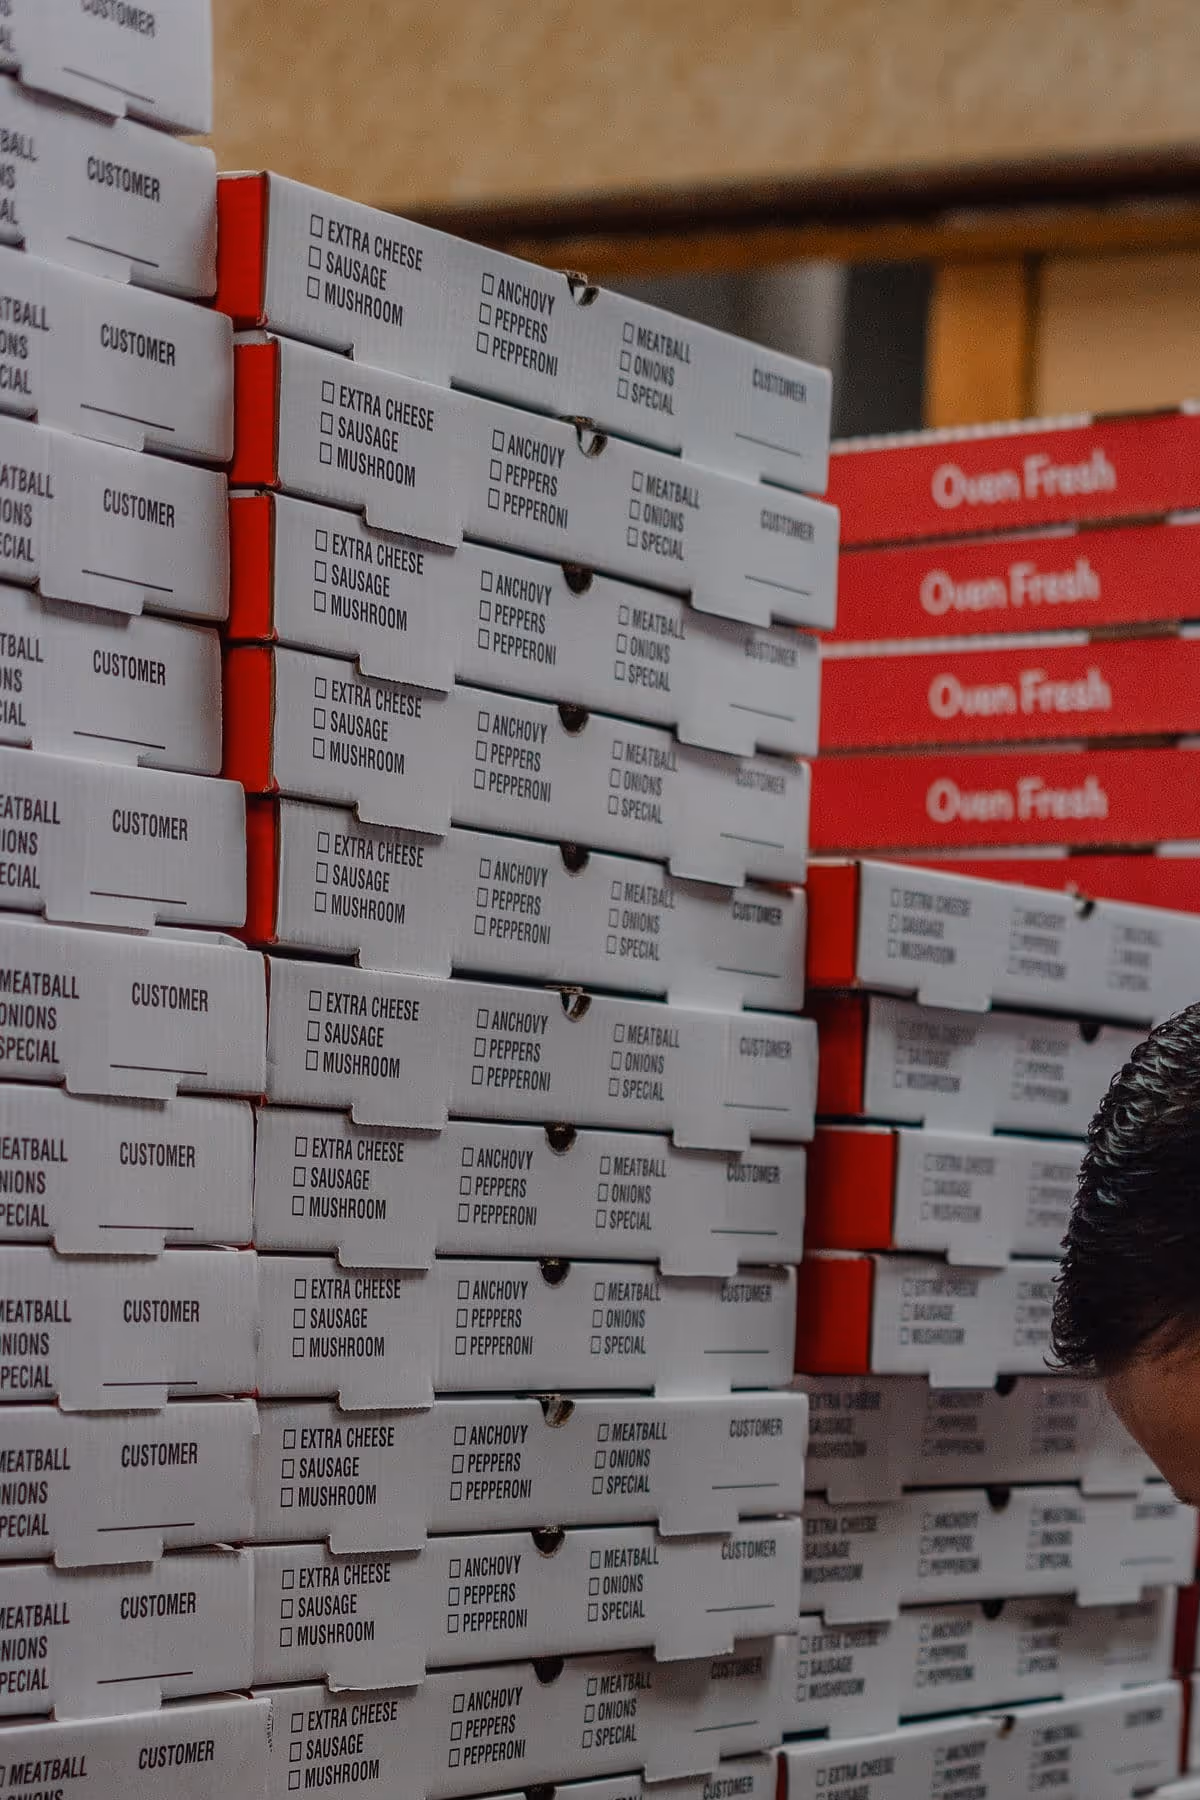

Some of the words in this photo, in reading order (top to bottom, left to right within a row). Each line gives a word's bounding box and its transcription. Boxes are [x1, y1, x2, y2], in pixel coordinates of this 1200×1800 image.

[87, 156, 160, 201] CUSTOMER
[327, 219, 369, 254] EXTRA
[373, 234, 423, 272] CHEESE
[326, 250, 387, 292] SAUSAGE
[324, 280, 403, 328] MUSHROOM
[496, 277, 555, 316] ANCHOVY
[494, 306, 548, 345] PEPPERS
[101, 323, 176, 366] CUSTOMER
[492, 335, 558, 377] PEPPERONI
[339, 384, 381, 417] EXTRA
[385, 397, 434, 432] CHEESE
[338, 415, 399, 453] SAUSAGE
[506, 433, 565, 469] ANCHOVY
[337, 445, 415, 488] MUSHROOM
[505, 462, 558, 497] PEPPERS
[931, 463, 1021, 509] Oven
[1024, 448, 1116, 498] Fresh
[104, 488, 174, 528] CUSTOMER
[503, 491, 568, 529] PEPPERONI
[332, 532, 372, 563] EXTRA
[376, 543, 424, 575] CHEESE
[331, 563, 390, 598] SAUSAGE
[495, 573, 552, 606] ANCHOVY
[920, 569, 1006, 615] Oven
[1009, 555, 1100, 606] Fresh
[331, 593, 407, 632] MUSHROOM
[494, 602, 545, 635] PEPPERS
[493, 631, 556, 666] PEPPERONI
[94, 650, 166, 686] CUSTOMER
[331, 679, 371, 708] EXTRA
[375, 688, 422, 719] CHEESE
[928, 673, 1017, 719] Oven
[1020, 664, 1112, 711] Fresh
[330, 709, 388, 742] SAUSAGE
[491, 713, 548, 744] ANCHOVY
[329, 739, 404, 775] MUSHROOM
[490, 742, 541, 772] PEPPERS
[488, 770, 551, 803] PEPPERONI
[926, 778, 1013, 823] Oven
[1016, 772, 1108, 819] Fresh
[113, 809, 188, 841] CUSTOMER
[334, 833, 373, 860] EXTRA
[377, 840, 424, 868] CHEESE
[332, 863, 390, 893] SAUSAGE
[493, 860, 548, 888] ANCHOVY
[331, 892, 405, 925] MUSHROOM
[491, 888, 541, 916] PEPPERS
[489, 916, 550, 945] PEPPERONI
[0, 968, 80, 1000] MEATBALL
[132, 982, 208, 1012] CUSTOMER
[326, 991, 367, 1016] EXTRA
[371, 995, 420, 1022] CHEESE
[324, 1021, 384, 1048] SAUSAGE
[491, 1009, 548, 1035] ANCHOVY
[322, 1050, 400, 1079] MUSHROOM
[489, 1038, 541, 1063] PEPPERS
[486, 1066, 551, 1092] PEPPERONI
[120, 1142, 196, 1168] CUSTOMER
[312, 1136, 352, 1160] EXTRA
[356, 1139, 404, 1163] CHEESE
[476, 1147, 533, 1170] ANCHOVY
[310, 1166, 370, 1190] SAUSAGE
[474, 1175, 527, 1198] PEPPERS
[309, 1195, 386, 1220] MUSHROOM
[473, 1203, 537, 1226] PEPPERONI
[311, 1278, 350, 1299] EXTRA
[354, 1278, 401, 1299] CHEESE
[472, 1280, 528, 1300] ANCHOVY
[124, 1299, 200, 1323] CUSTOMER
[310, 1307, 368, 1328] SAUSAGE
[471, 1308, 522, 1328] PEPPERS
[309, 1336, 384, 1357] MUSHROOM
[470, 1335, 533, 1355] PEPPERONI
[300, 1427, 342, 1449] EXTRA
[346, 1426, 395, 1448] CHEESE
[468, 1423, 528, 1445] ANCHOVY
[612, 1421, 668, 1442] MEATBALL
[121, 1442, 198, 1468] CUSTOMER
[299, 1456, 360, 1478] SAUSAGE
[467, 1452, 521, 1473] PEPPERS
[610, 1448, 650, 1468] ONIONS
[298, 1484, 376, 1507] MUSHROOM
[465, 1478, 531, 1500] PEPPERONI
[606, 1473, 650, 1495] SPECIAL
[603, 1546, 659, 1569] MEATBALL
[721, 1539, 777, 1561] CUSTOMER
[299, 1565, 339, 1588] EXTRA
[343, 1561, 391, 1585] CHEESE
[464, 1554, 521, 1578] ANCHOVY
[463, 1582, 515, 1605] PEPPERS
[602, 1574, 643, 1596] ONIONS
[120, 1592, 196, 1620] CUSTOMER
[298, 1593, 357, 1617] SAUSAGE
[602, 1600, 645, 1622] SPECIAL
[297, 1620, 374, 1646] MUSHROOM
[463, 1608, 527, 1632] PEPPERONI
[466, 1685, 522, 1712] ANCHOVY
[307, 1706, 347, 1731] EXTRA
[351, 1699, 398, 1726] CHEESE
[465, 1713, 516, 1739] PEPPERS
[138, 1738, 216, 1770] CUSTOMER
[306, 1732, 364, 1760] SAUSAGE
[463, 1738, 525, 1766] PEPPERONI
[9, 1755, 87, 1785] MEATBALL
[304, 1758, 379, 1788] MUSHROOM
